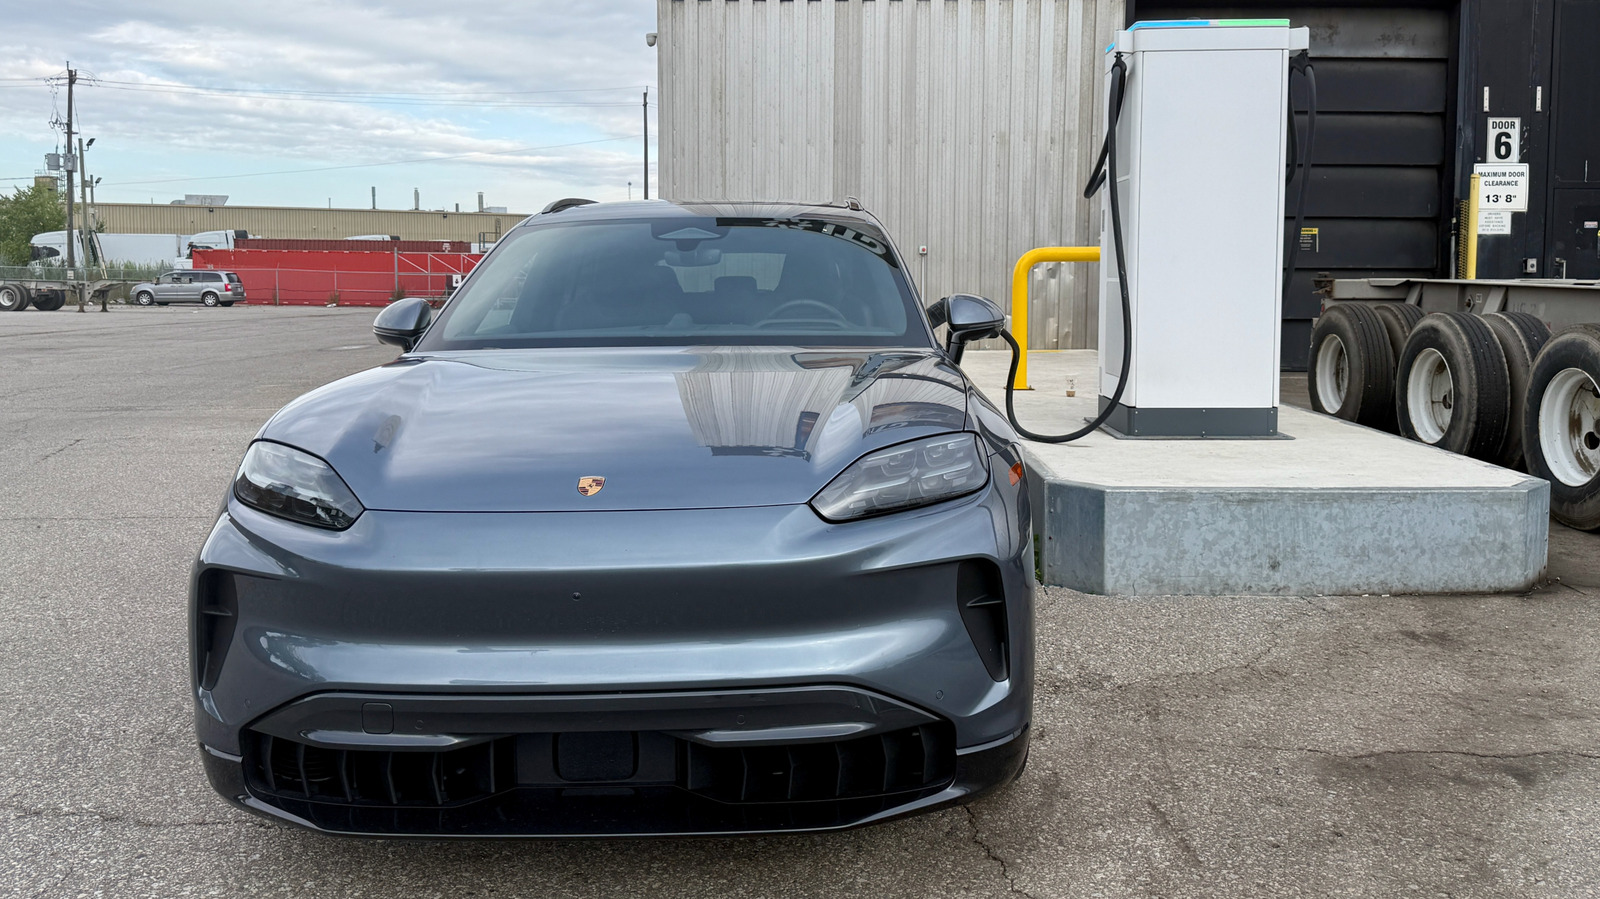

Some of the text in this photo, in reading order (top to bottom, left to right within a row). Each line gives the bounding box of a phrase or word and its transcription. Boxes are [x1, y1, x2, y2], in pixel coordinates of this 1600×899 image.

[1492, 121, 1516, 129] DOOR
[1495, 132, 1511, 160] 6
[1485, 194, 1517, 203] 13' 8"
